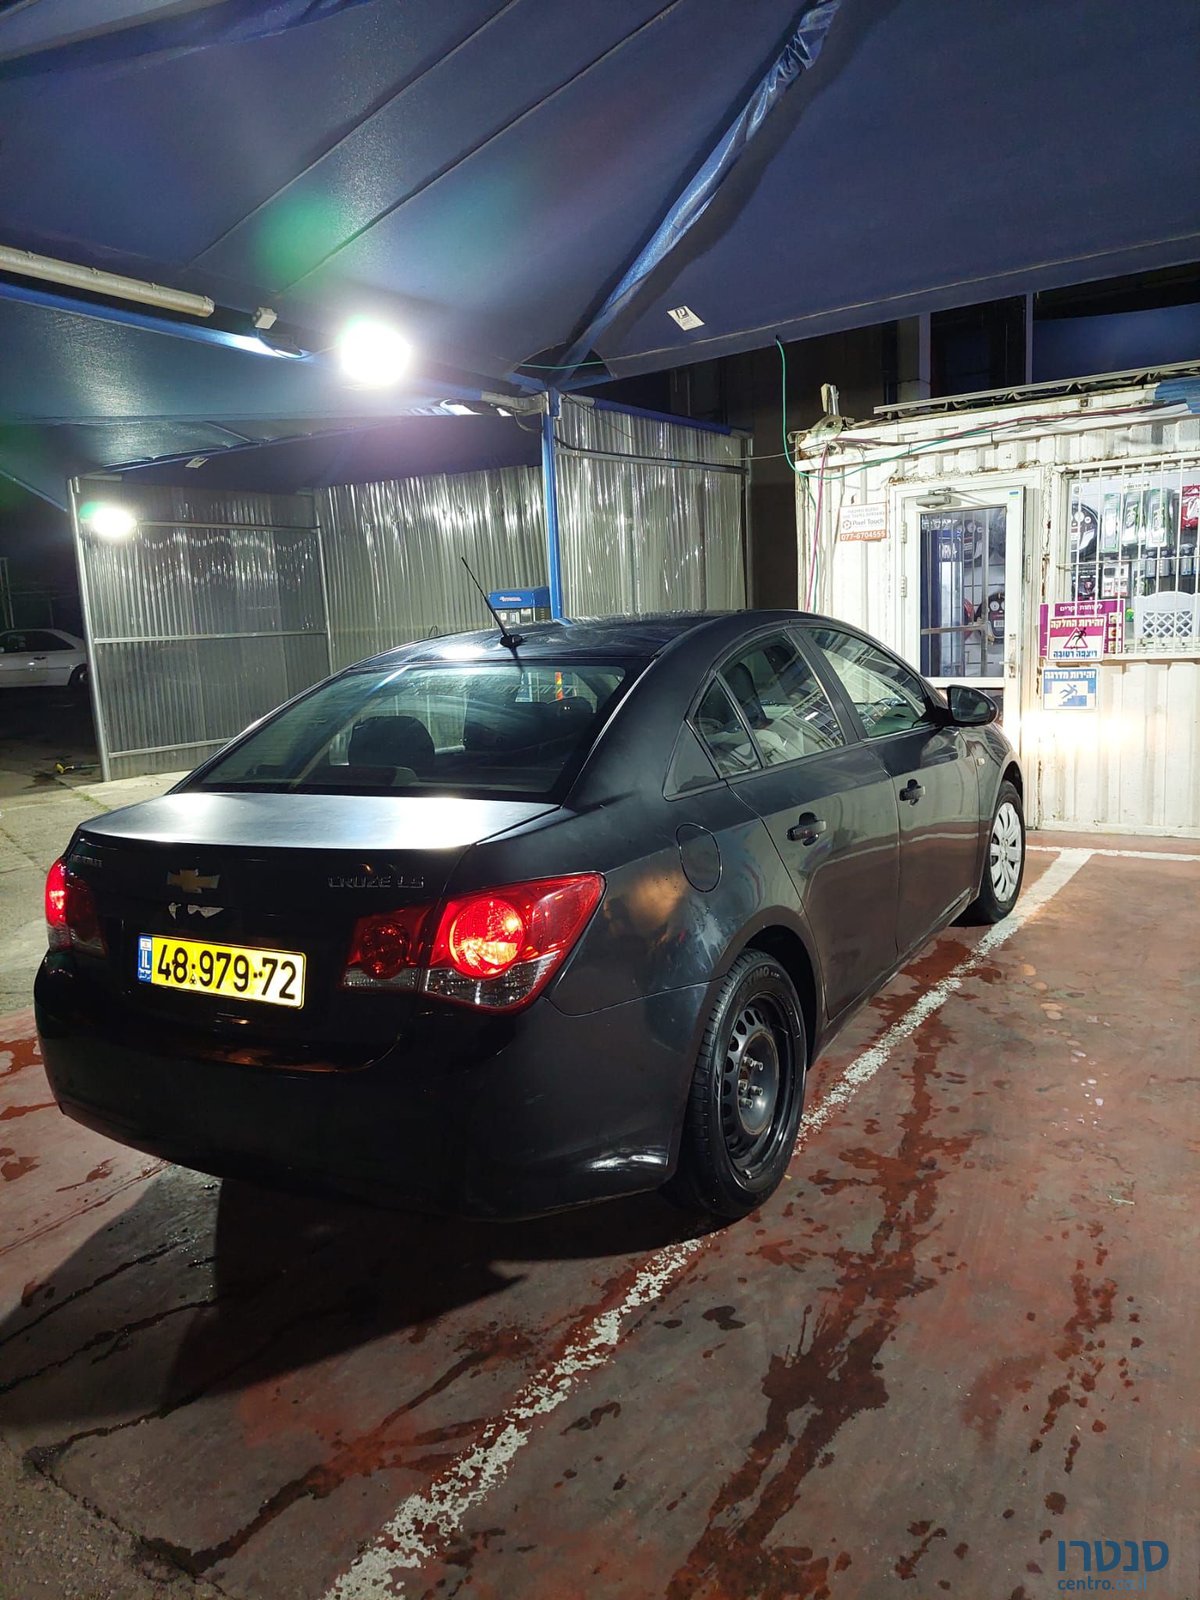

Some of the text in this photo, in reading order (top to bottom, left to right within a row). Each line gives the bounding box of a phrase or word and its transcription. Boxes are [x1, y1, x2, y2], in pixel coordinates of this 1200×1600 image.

[1050, 618, 1104, 629] זהירות החלקה
[1053, 650, 1074, 658] רטובה
[1070, 670, 1096, 679] זהירות
[327, 876, 391, 888] CRUZE
